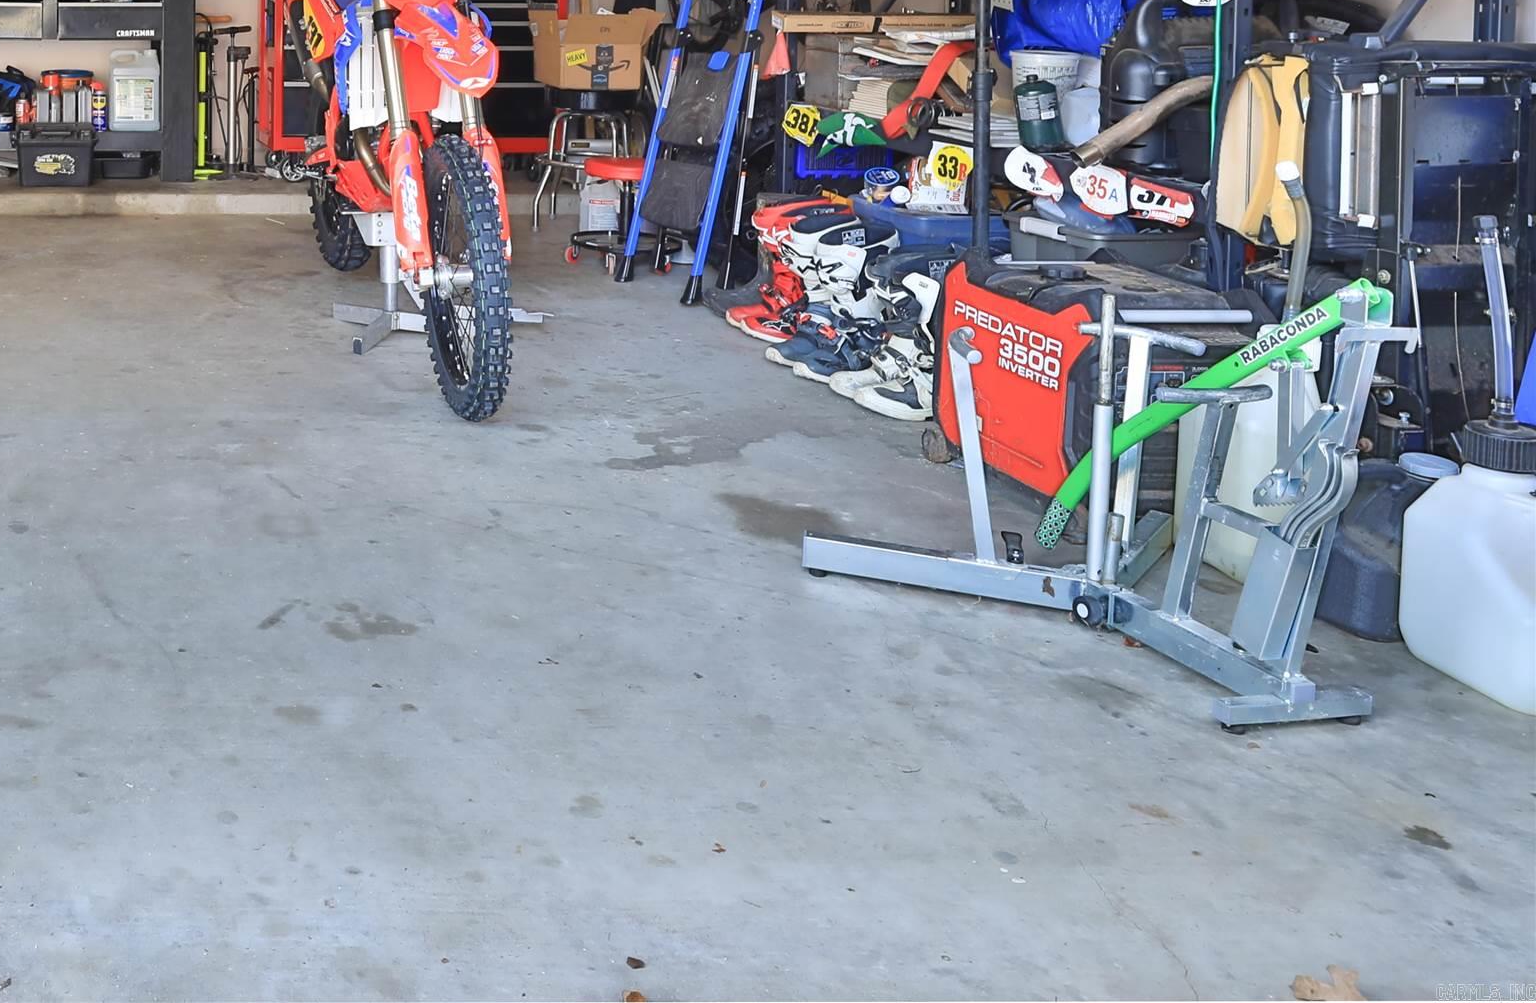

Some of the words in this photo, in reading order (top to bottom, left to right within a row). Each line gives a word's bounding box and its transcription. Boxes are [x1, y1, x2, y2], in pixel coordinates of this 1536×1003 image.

[116, 29, 155, 37] CRAFTSMAN
[566, 52, 587, 63] HEAVY
[954, 299, 1063, 359] PREDATOR
[1240, 307, 1328, 364] RABACONDA
[998, 337, 1061, 379] 3500
[998, 356, 1059, 391] INVERTER
